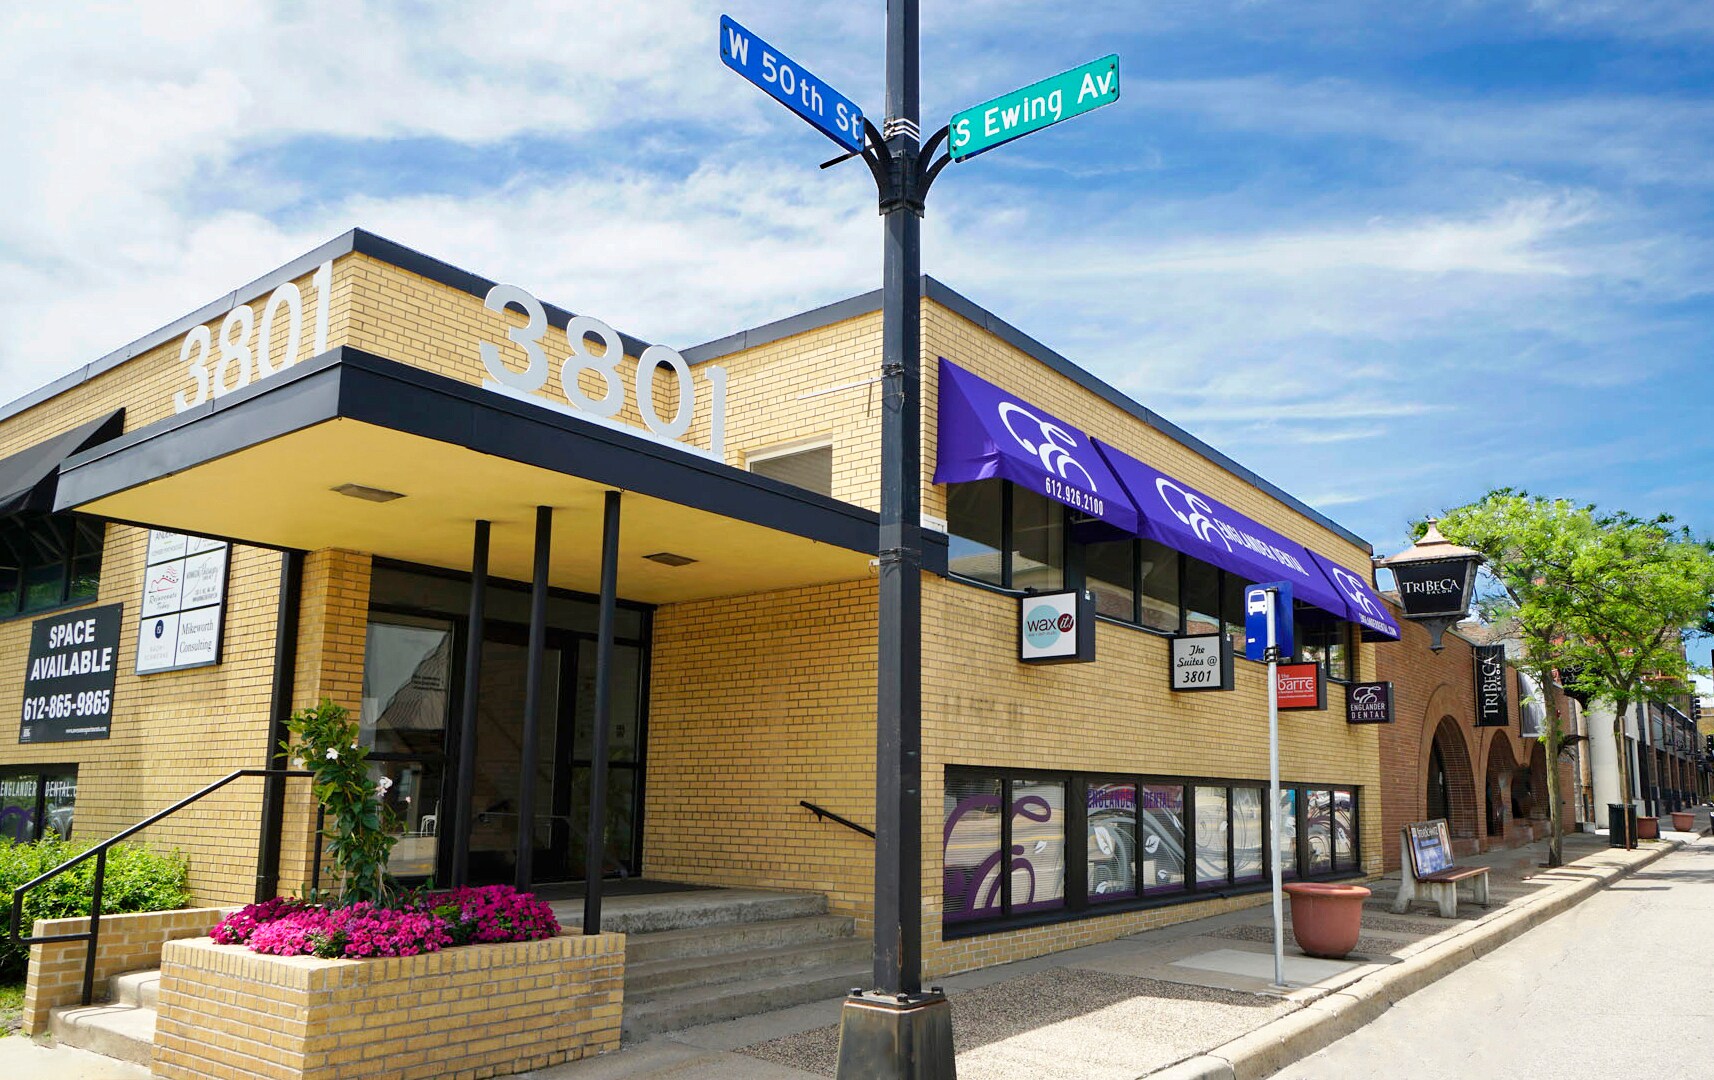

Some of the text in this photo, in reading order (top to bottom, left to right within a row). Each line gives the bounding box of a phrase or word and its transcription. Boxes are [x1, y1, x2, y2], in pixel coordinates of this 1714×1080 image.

[727, 28, 862, 141] W 50th St
[954, 72, 1113, 147] S Ewing Av
[174, 260, 334, 416] 3801
[478, 283, 728, 457] 3801
[1045, 477, 1104, 516] 612.926.2100
[49, 618, 96, 649] SPACE
[1027, 618, 1057, 632] wax
[179, 640, 212, 653] Consulting
[1188, 644, 1206, 657] The
[30, 647, 113, 681] AVAILABLE
[1177, 655, 1218, 668] Suites @
[1182, 669, 1212, 684] 3801
[1277, 674, 1314, 691] barre
[23, 690, 111, 721] 612-865-9865
[1350, 702, 1386, 712] ENGLANDER
[1351, 710, 1386, 719] DENTAL
[0, 781, 38, 797] ENGLANDER
